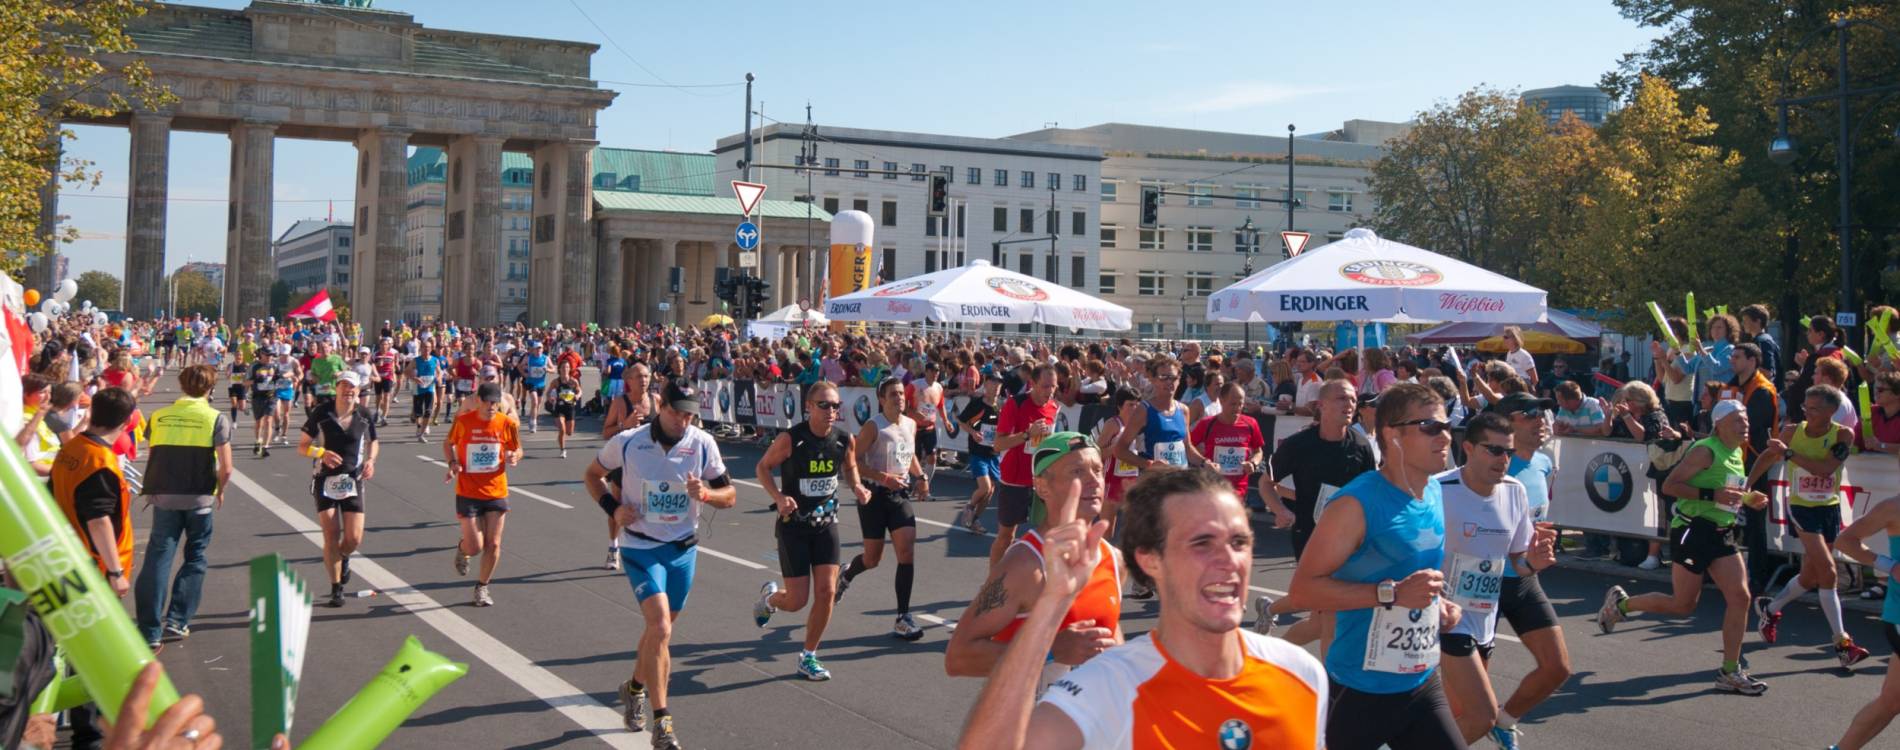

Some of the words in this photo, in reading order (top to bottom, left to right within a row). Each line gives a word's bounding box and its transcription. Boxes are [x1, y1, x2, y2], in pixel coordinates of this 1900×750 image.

[830, 302, 862, 314] ERDINGER
[960, 303, 1011, 318] ERDINGER
[1280, 294, 1369, 312] ERDINGER
[1439, 292, 1505, 314] Weißbier
[809, 460, 833, 473] BAS
[1590, 454, 1629, 475] BMW
[1801, 477, 1834, 489] 3413
[651, 494, 687, 509] 34942
